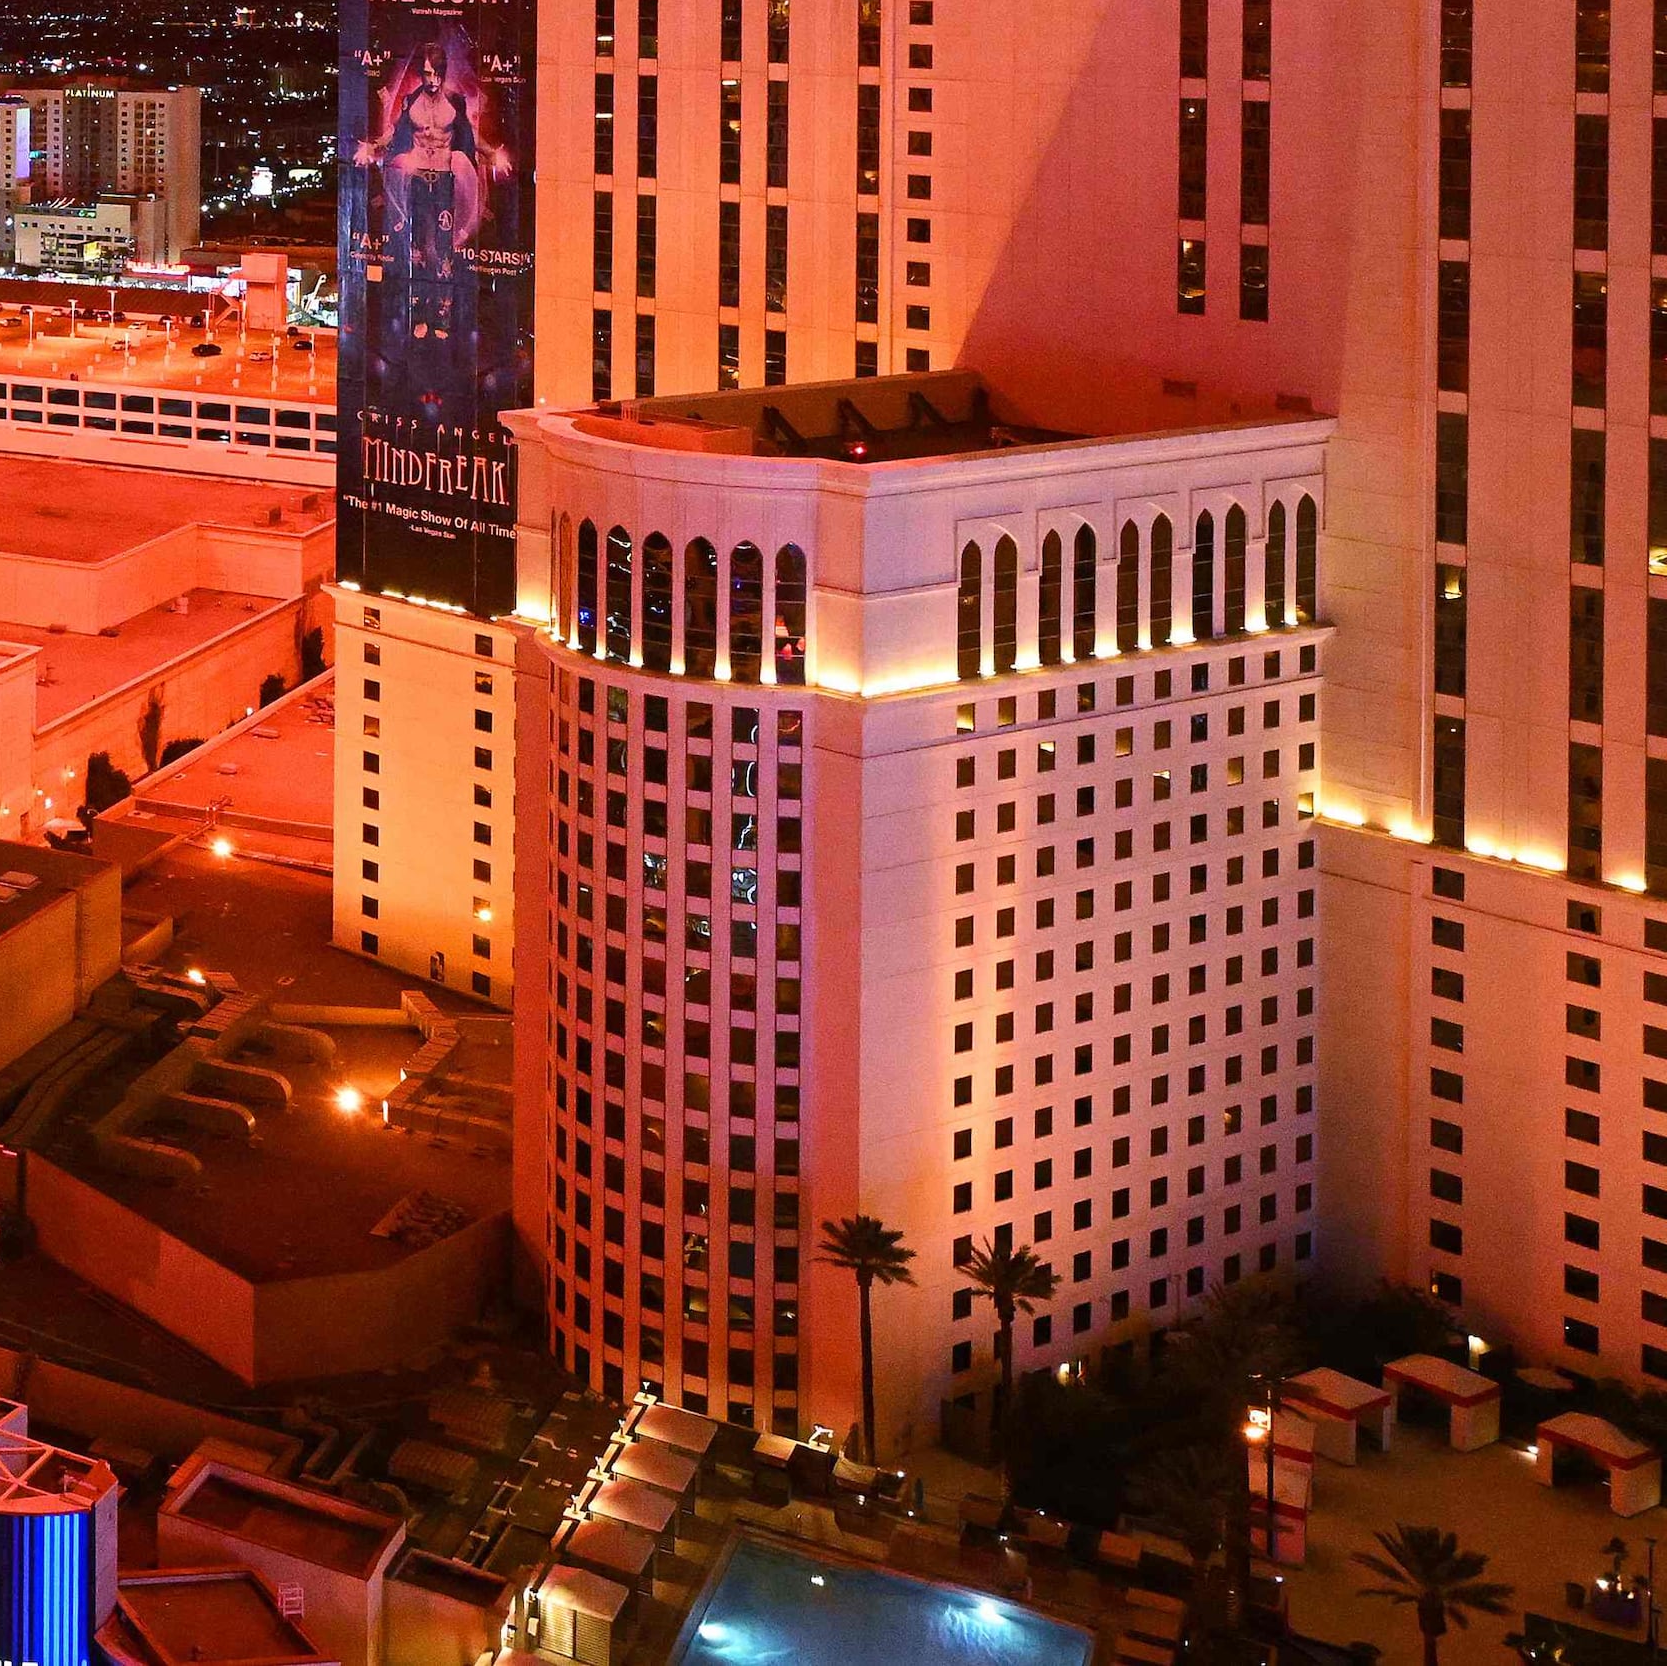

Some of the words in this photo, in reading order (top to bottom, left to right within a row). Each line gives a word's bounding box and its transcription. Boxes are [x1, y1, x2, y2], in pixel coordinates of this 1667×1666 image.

[65, 88, 115, 99] PLATINUM
[357, 410, 417, 430] CRISS
[437, 423, 513, 446] ANGEL
[385, 502, 419, 520] Magic
[421, 509, 452, 528] Show
[454, 517, 469, 529] Of
[470, 520, 486, 534] All
[424, 526, 442, 537] Vegas
